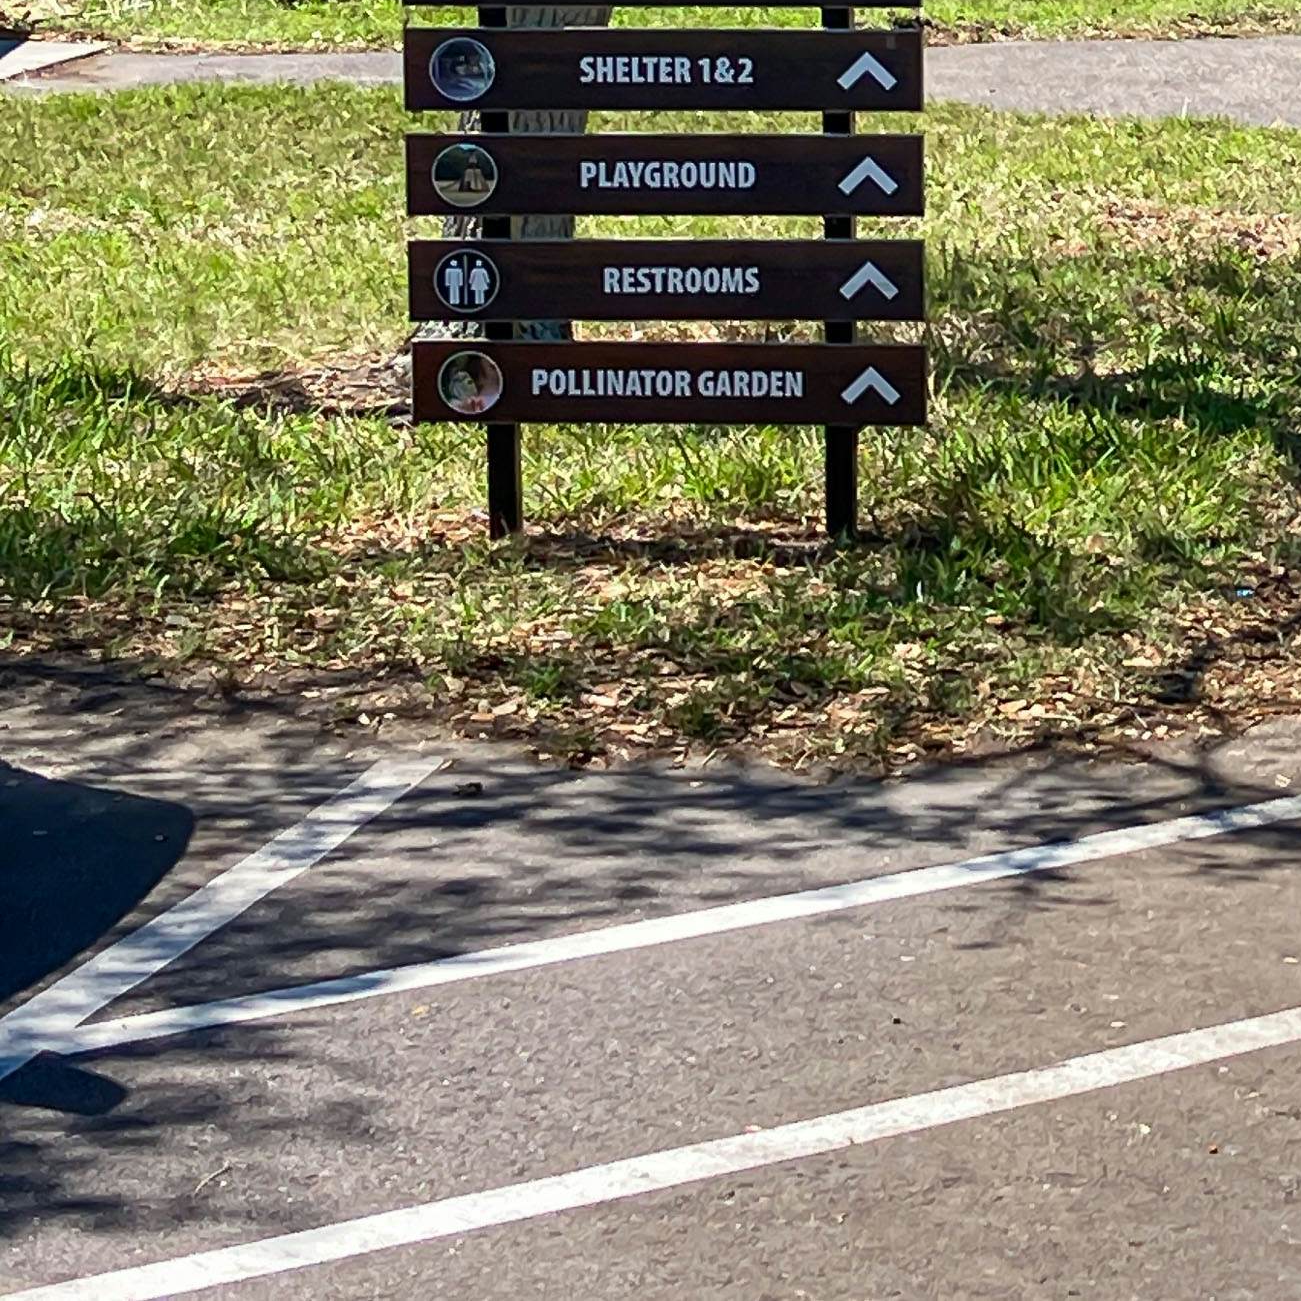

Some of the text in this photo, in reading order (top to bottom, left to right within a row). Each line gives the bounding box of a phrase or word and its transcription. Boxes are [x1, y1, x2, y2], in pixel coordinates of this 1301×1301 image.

[579, 56, 754, 84] SHELTER 1&2
[580, 161, 756, 189] PLAYGROUND
[603, 266, 760, 294] RESTROOMS
[532, 368, 803, 398] POLLINATOR GARDEN
